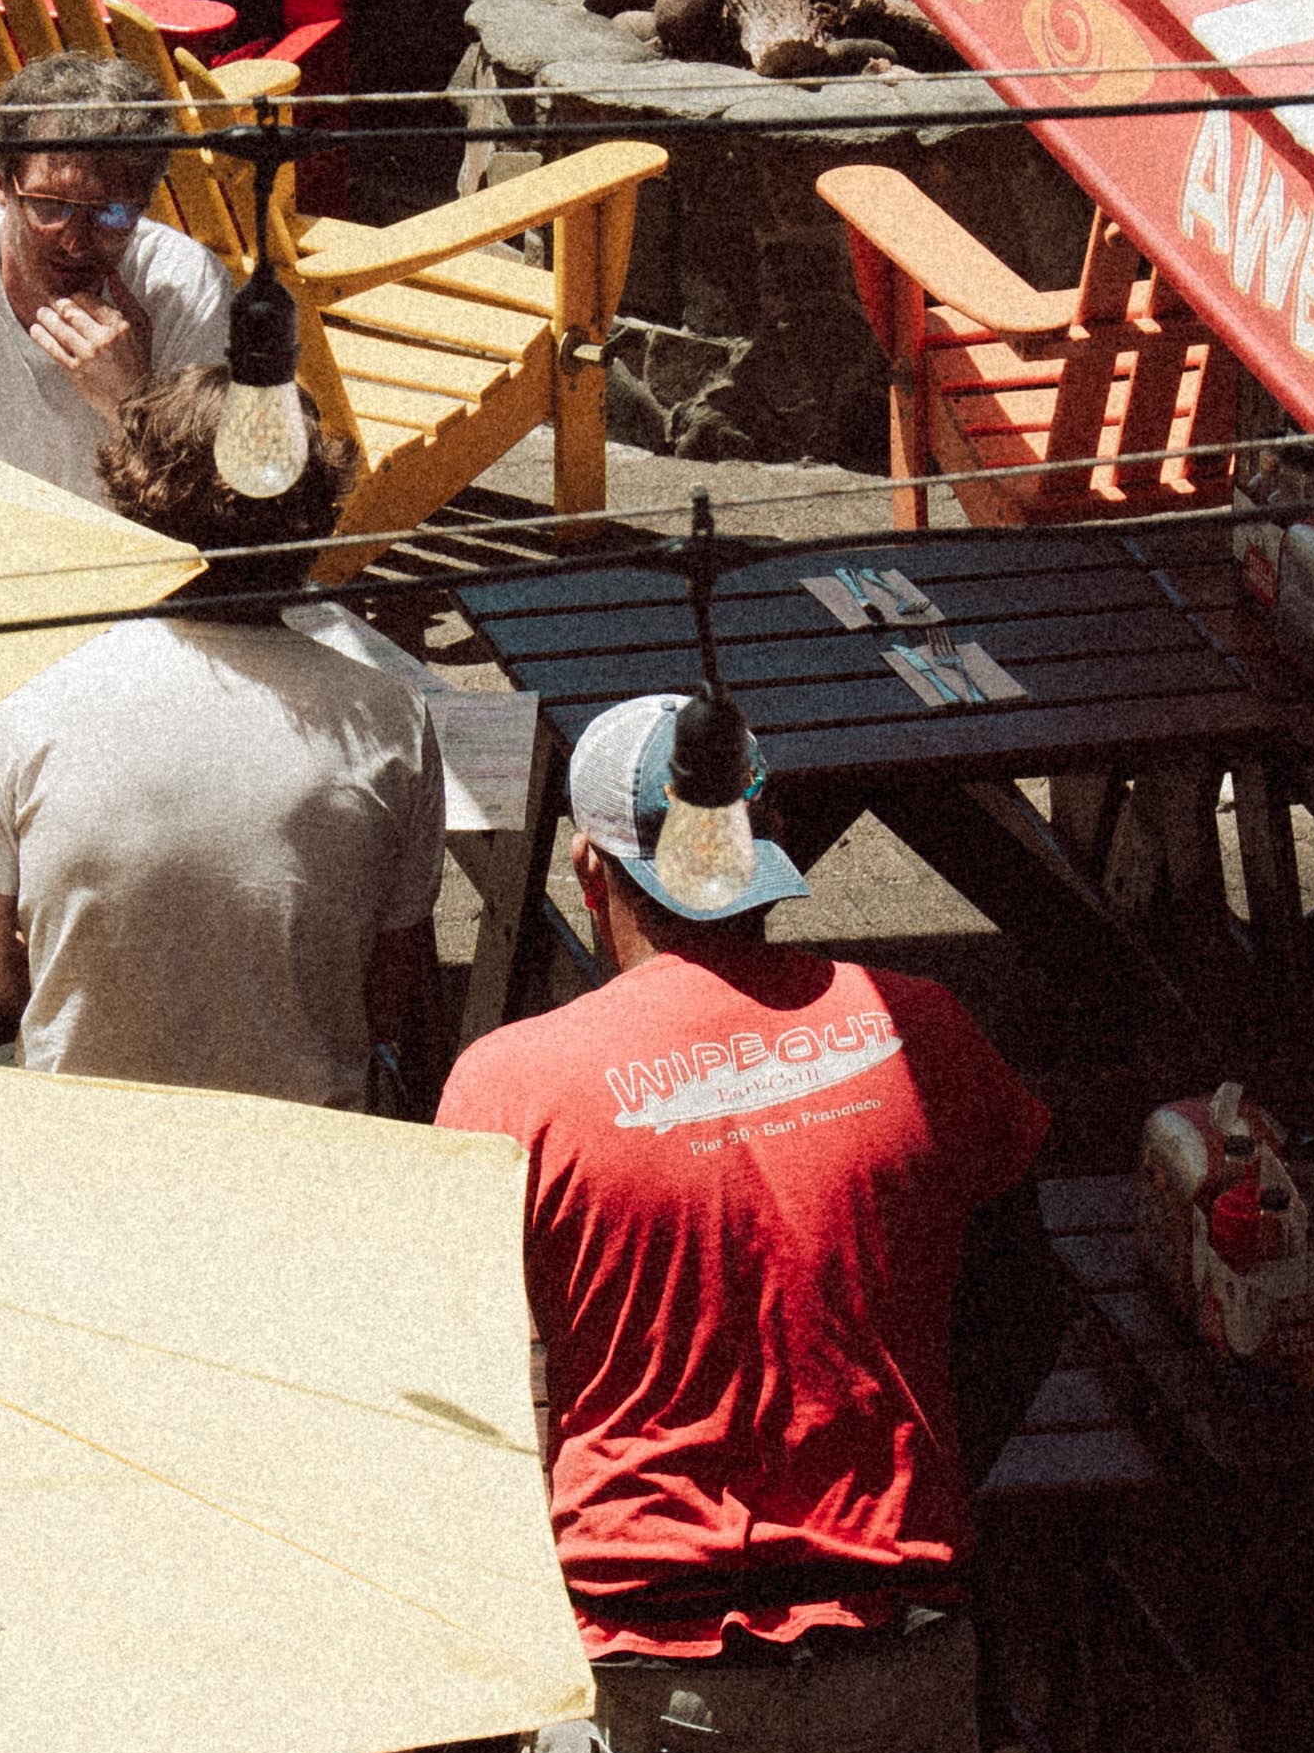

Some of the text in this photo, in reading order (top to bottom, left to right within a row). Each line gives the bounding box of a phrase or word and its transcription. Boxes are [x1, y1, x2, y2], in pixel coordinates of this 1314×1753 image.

[605, 1011, 894, 1114] WIPEOUT
[690, 1137, 723, 1156] Pier
[762, 1120, 797, 1137] San
[800, 1098, 883, 1127] Francisco
